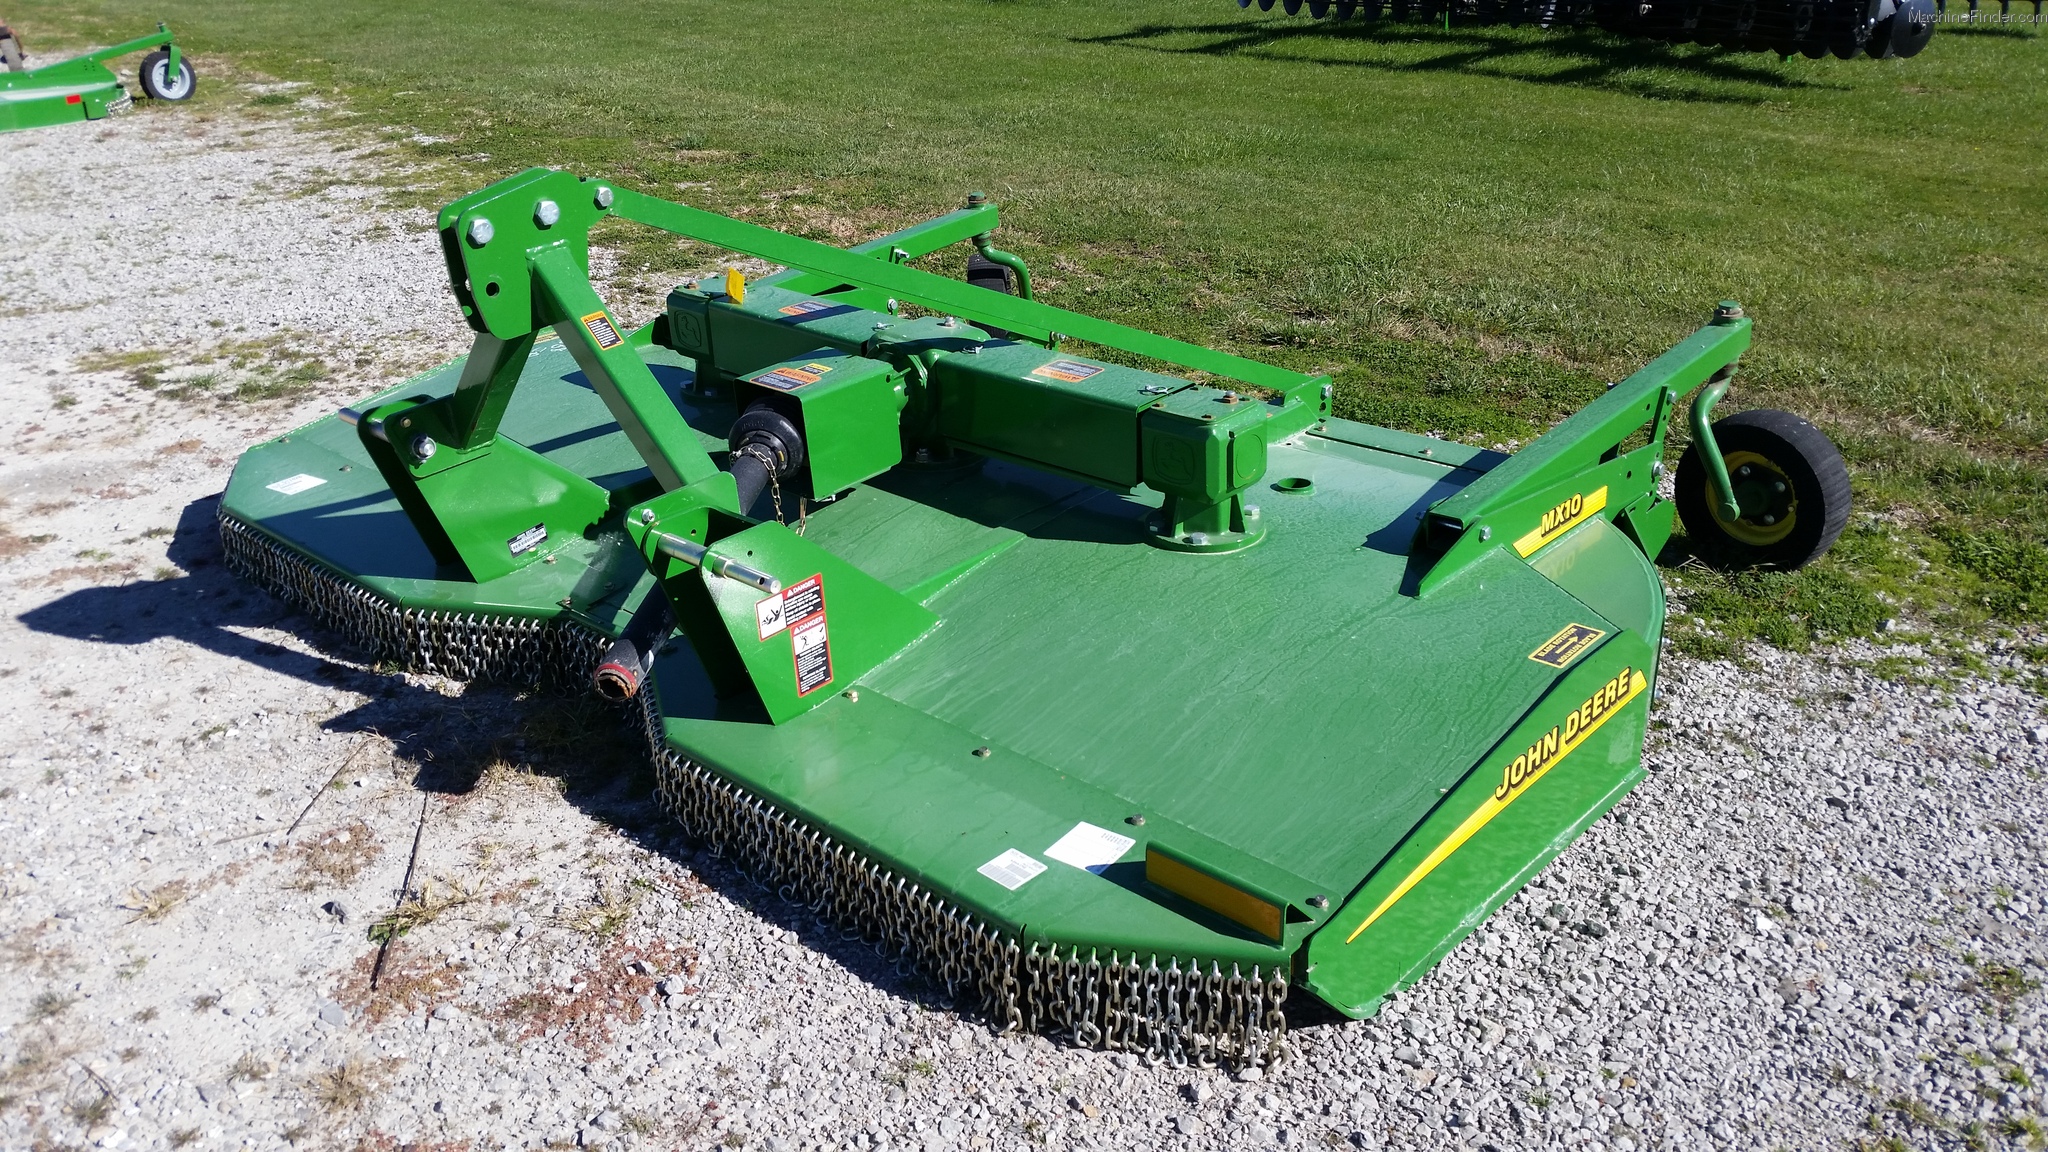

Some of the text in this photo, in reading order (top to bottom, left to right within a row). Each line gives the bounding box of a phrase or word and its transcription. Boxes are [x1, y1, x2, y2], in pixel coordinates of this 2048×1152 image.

[1541, 493, 1583, 537] MX10
[793, 578, 815, 593] DANGER
[800, 615, 823, 631] DANGER
[1537, 628, 1578, 656] BLADE ROTATION
[1494, 666, 1632, 800] JOHN DEERE
